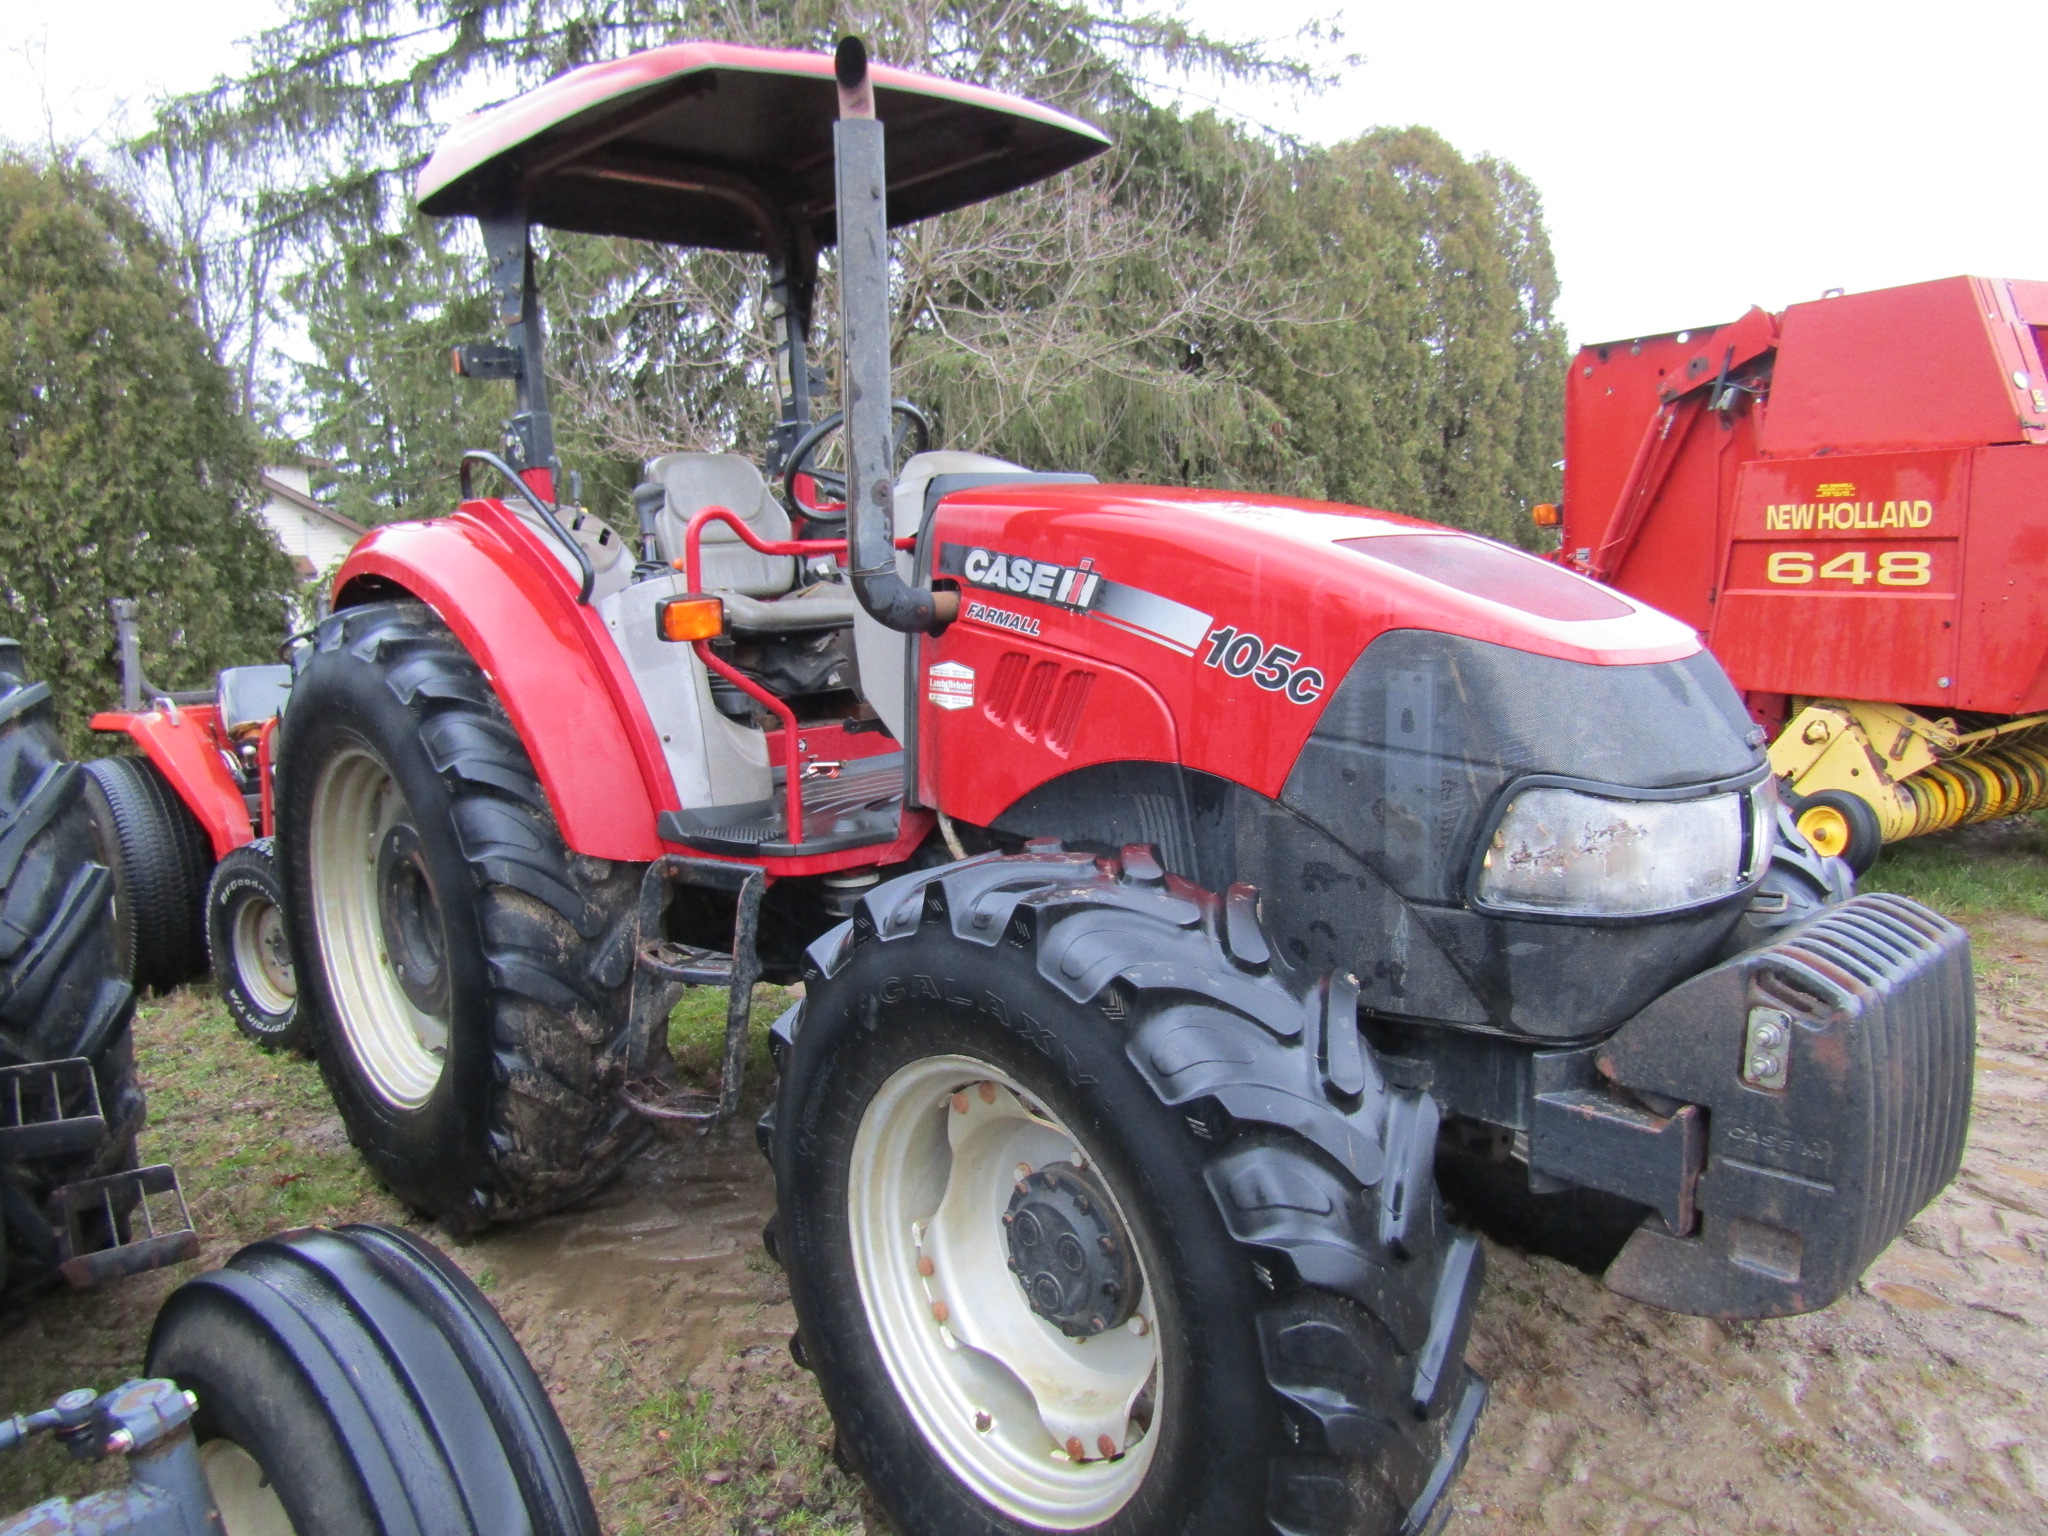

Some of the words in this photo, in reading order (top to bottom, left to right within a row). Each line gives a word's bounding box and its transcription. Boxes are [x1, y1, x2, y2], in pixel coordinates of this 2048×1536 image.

[1766, 504, 1815, 531] NEW
[1817, 500, 1932, 530] HOLLAND
[964, 549, 1060, 599] CASE
[1767, 551, 1932, 586] 648
[965, 602, 1041, 637] FARMALL
[878, 974, 1099, 1087] GALAXY
